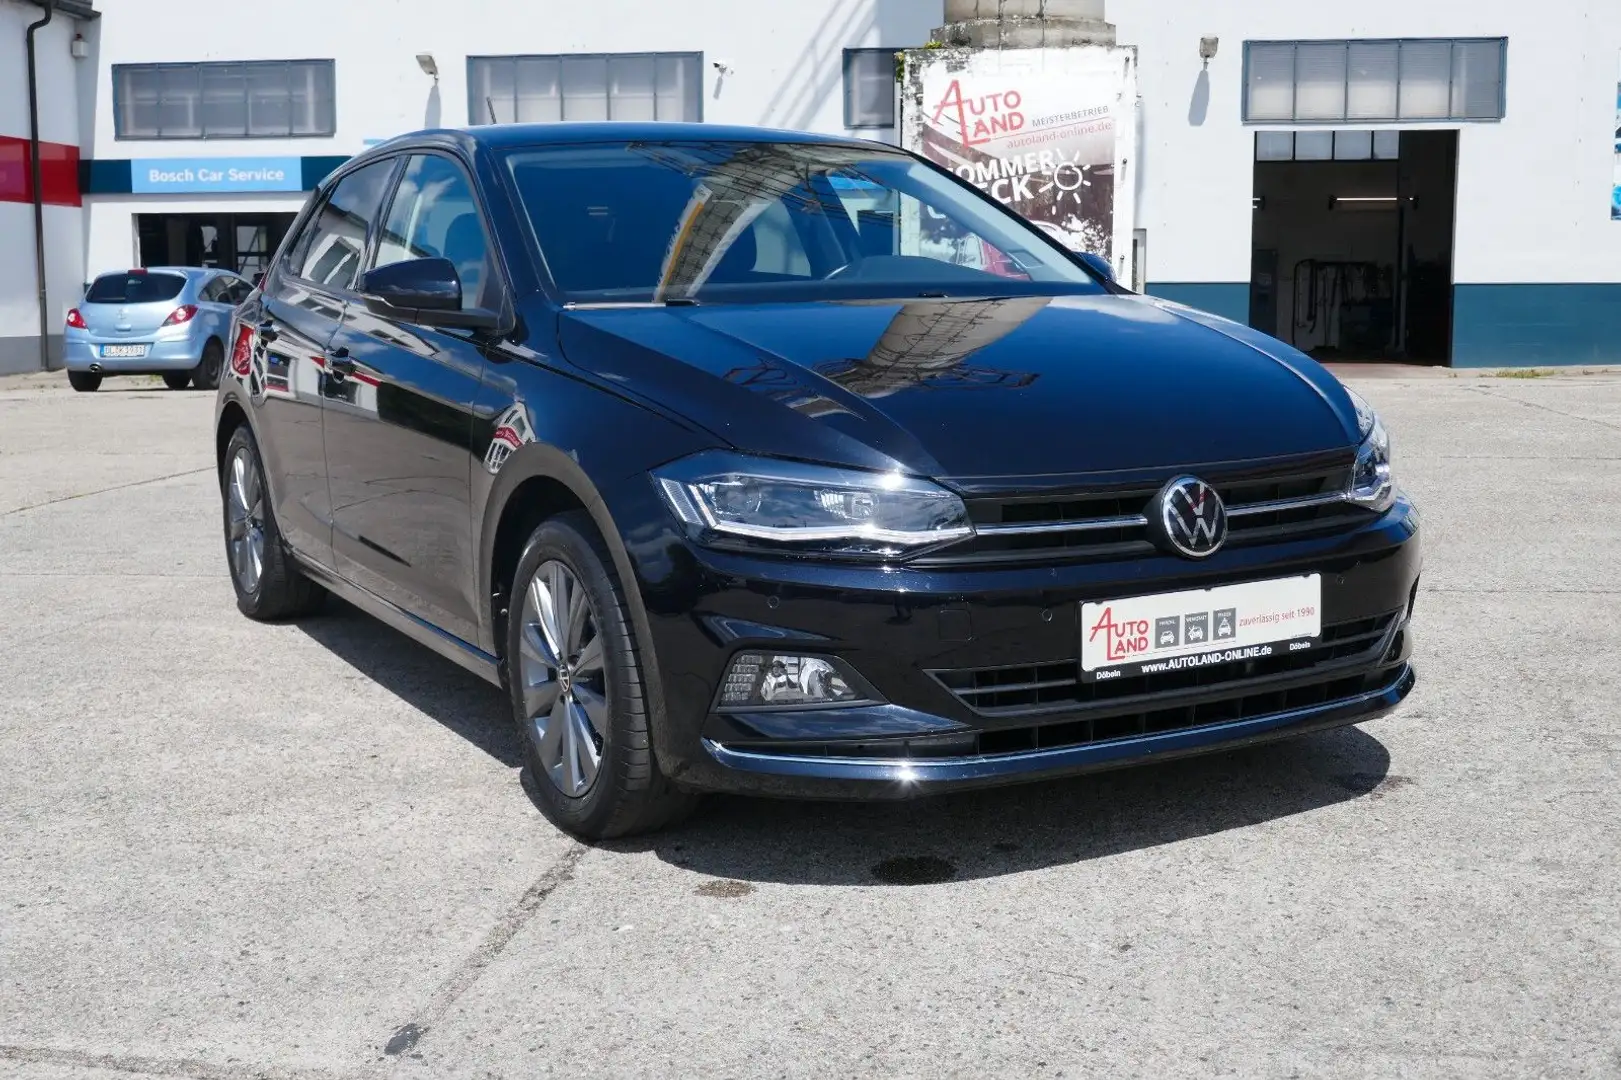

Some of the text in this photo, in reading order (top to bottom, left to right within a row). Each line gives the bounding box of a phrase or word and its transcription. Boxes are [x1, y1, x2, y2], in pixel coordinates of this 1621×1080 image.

[932, 79, 1021, 124] AUTO
[1032, 105, 1109, 127] MEISTERBETRIEB
[1007, 121, 1112, 149] autoland-online.de
[149, 167, 284, 182] Bosch Car Service
[947, 148, 1056, 184] OMMER
[1089, 607, 1149, 642] AUTO
[1297, 606, 1315, 618] 1990
[1107, 632, 1149, 661] LAND
[1141, 645, 1273, 674] www.AUTOLAND-ONLINE.de
